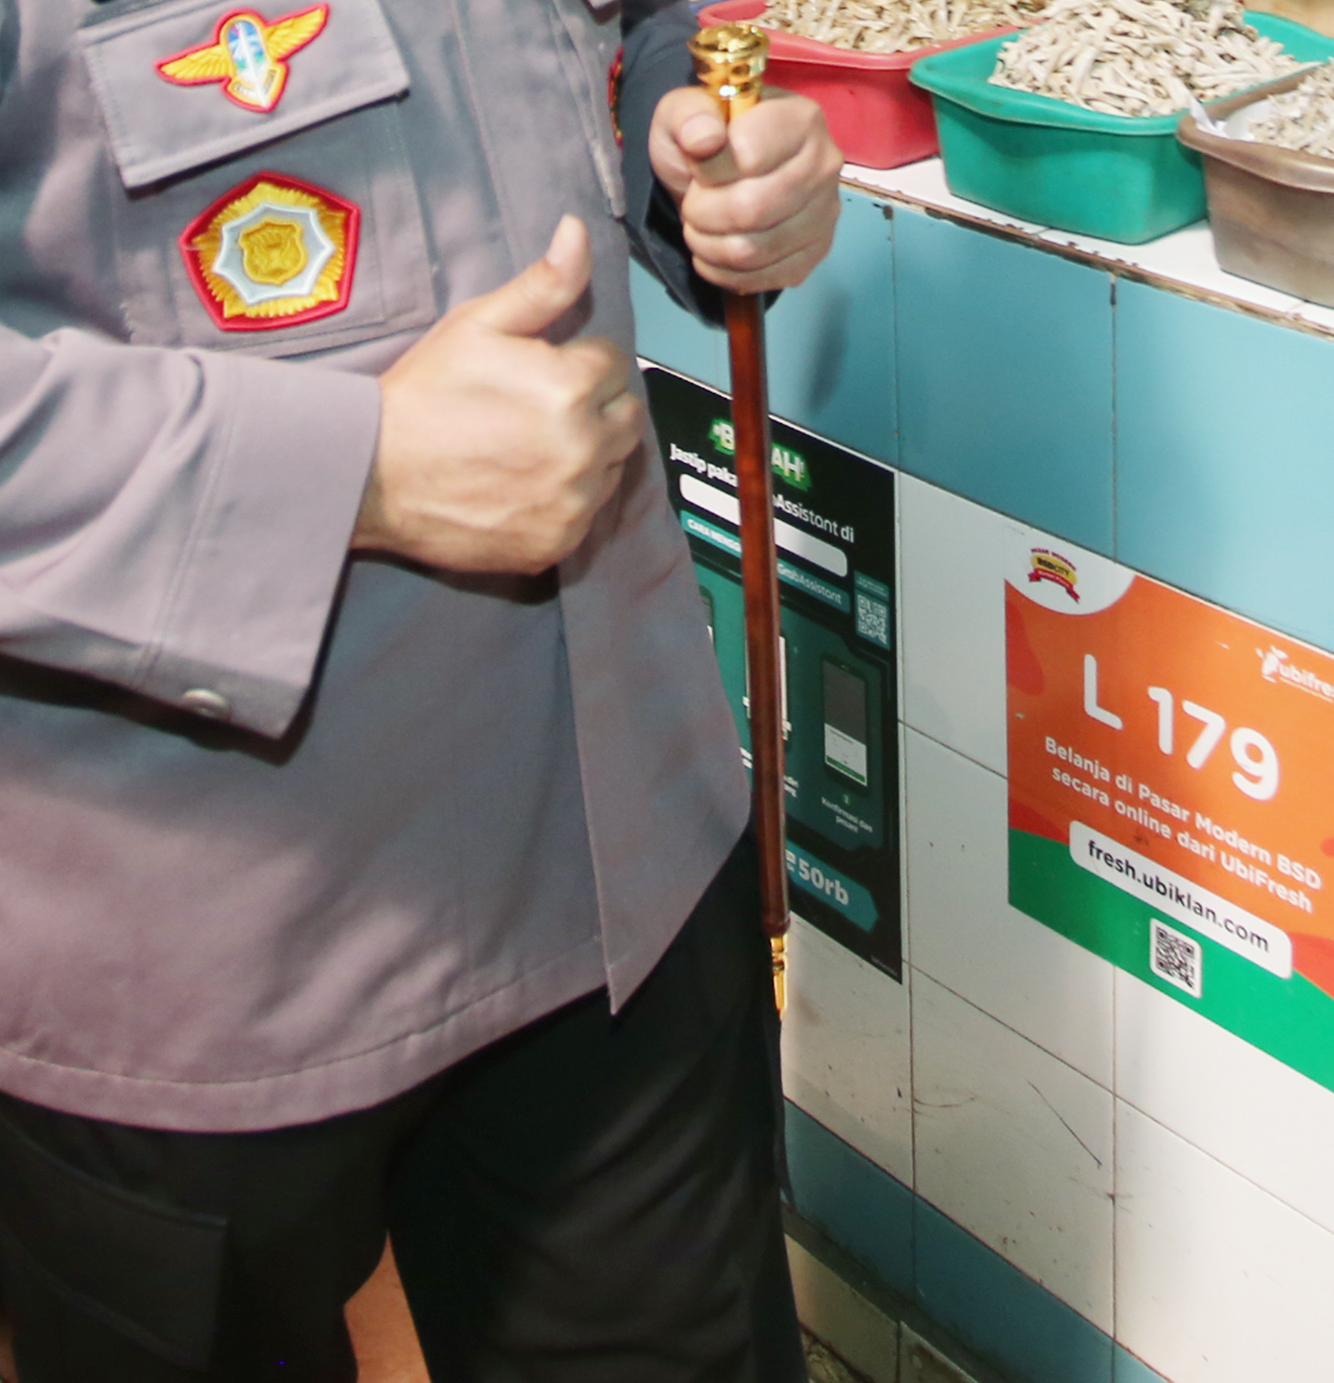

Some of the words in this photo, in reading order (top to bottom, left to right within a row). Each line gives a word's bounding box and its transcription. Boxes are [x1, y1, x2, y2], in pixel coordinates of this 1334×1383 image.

[670, 443, 708, 474] Jastip
[840, 526, 855, 544] di
[1084, 653, 1123, 730] L
[1147, 685, 1280, 801] 179
[1044, 736, 1110, 783] Belanja
[1115, 774, 1133, 794] di
[1138, 783, 1190, 822] Pasar
[1195, 812, 1272, 866] Modern
[1277, 853, 1323, 891] BSD
[1052, 767, 1110, 806] secara
[1114, 799, 1172, 839] online
[1177, 828, 1216, 862] dari
[1220, 851, 1313, 914] UbiFresh
[798, 858, 850, 906] 50rb
[1087, 839, 1270, 953] fresh.ubiklan.com
